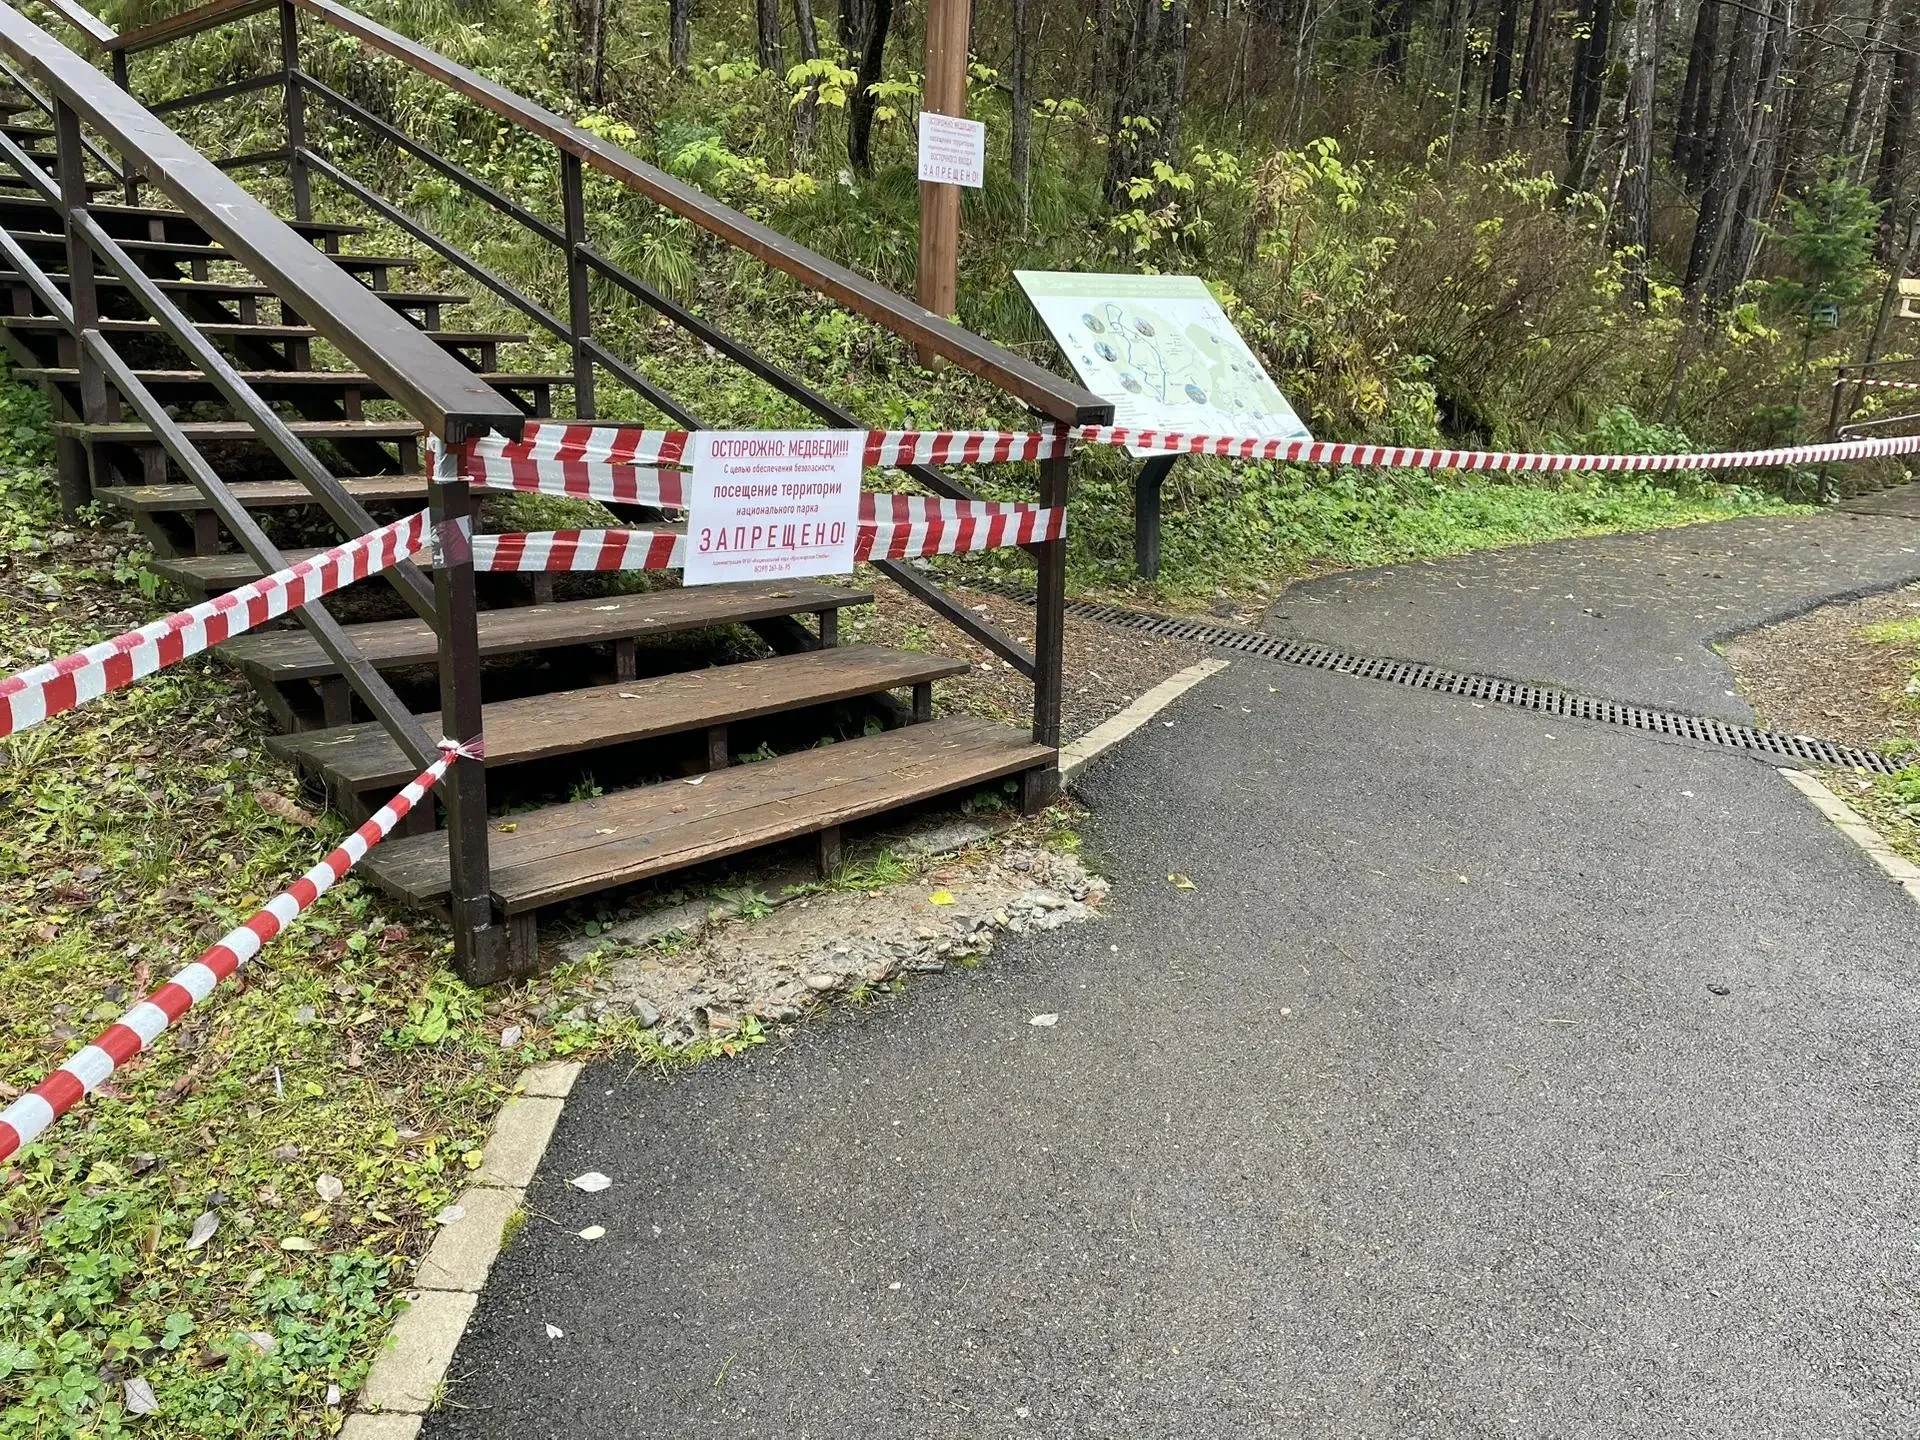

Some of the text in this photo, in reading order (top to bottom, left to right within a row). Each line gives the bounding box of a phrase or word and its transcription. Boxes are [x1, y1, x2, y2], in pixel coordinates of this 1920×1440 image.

[923, 164, 979, 182] ЗАПРЕЩЕНО!
[711, 439, 849, 459] ОСТОРОЖНО: МЕДВЕДИ!!!
[723, 463, 836, 475] С целью обеспечения безопасности,
[713, 482, 842, 500] посещение территории
[736, 504, 819, 517] национального парка
[699, 522, 846, 551] ЗАПРЕЩЕНО!
